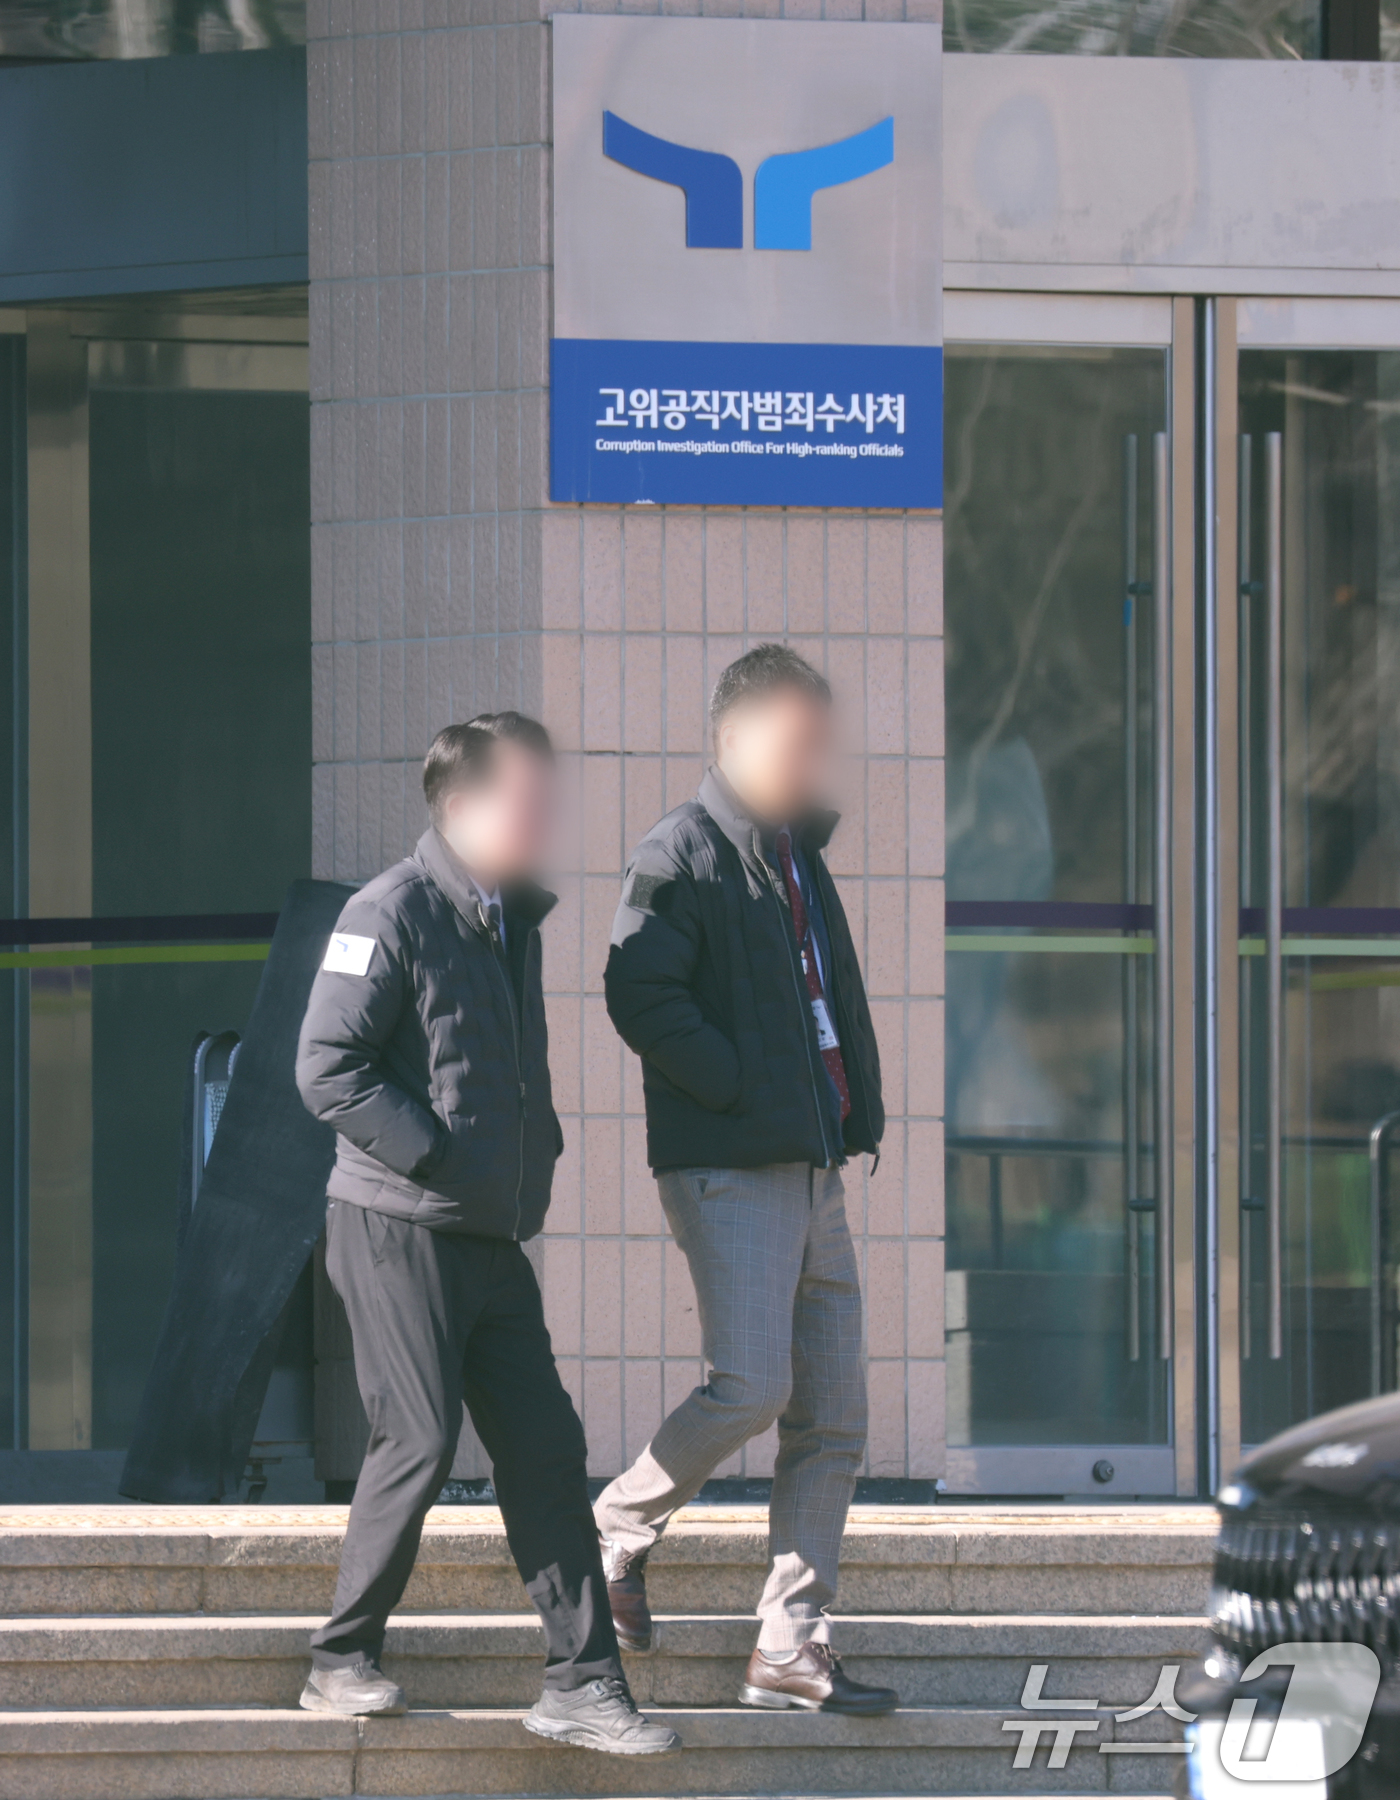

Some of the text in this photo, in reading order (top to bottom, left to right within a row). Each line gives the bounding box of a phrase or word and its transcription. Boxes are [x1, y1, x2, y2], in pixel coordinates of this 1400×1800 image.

[596, 388, 905, 434] 고위공직자범죄수사처
[595, 438, 904, 459] Corruption Investigation Office For High-ranking Officials
